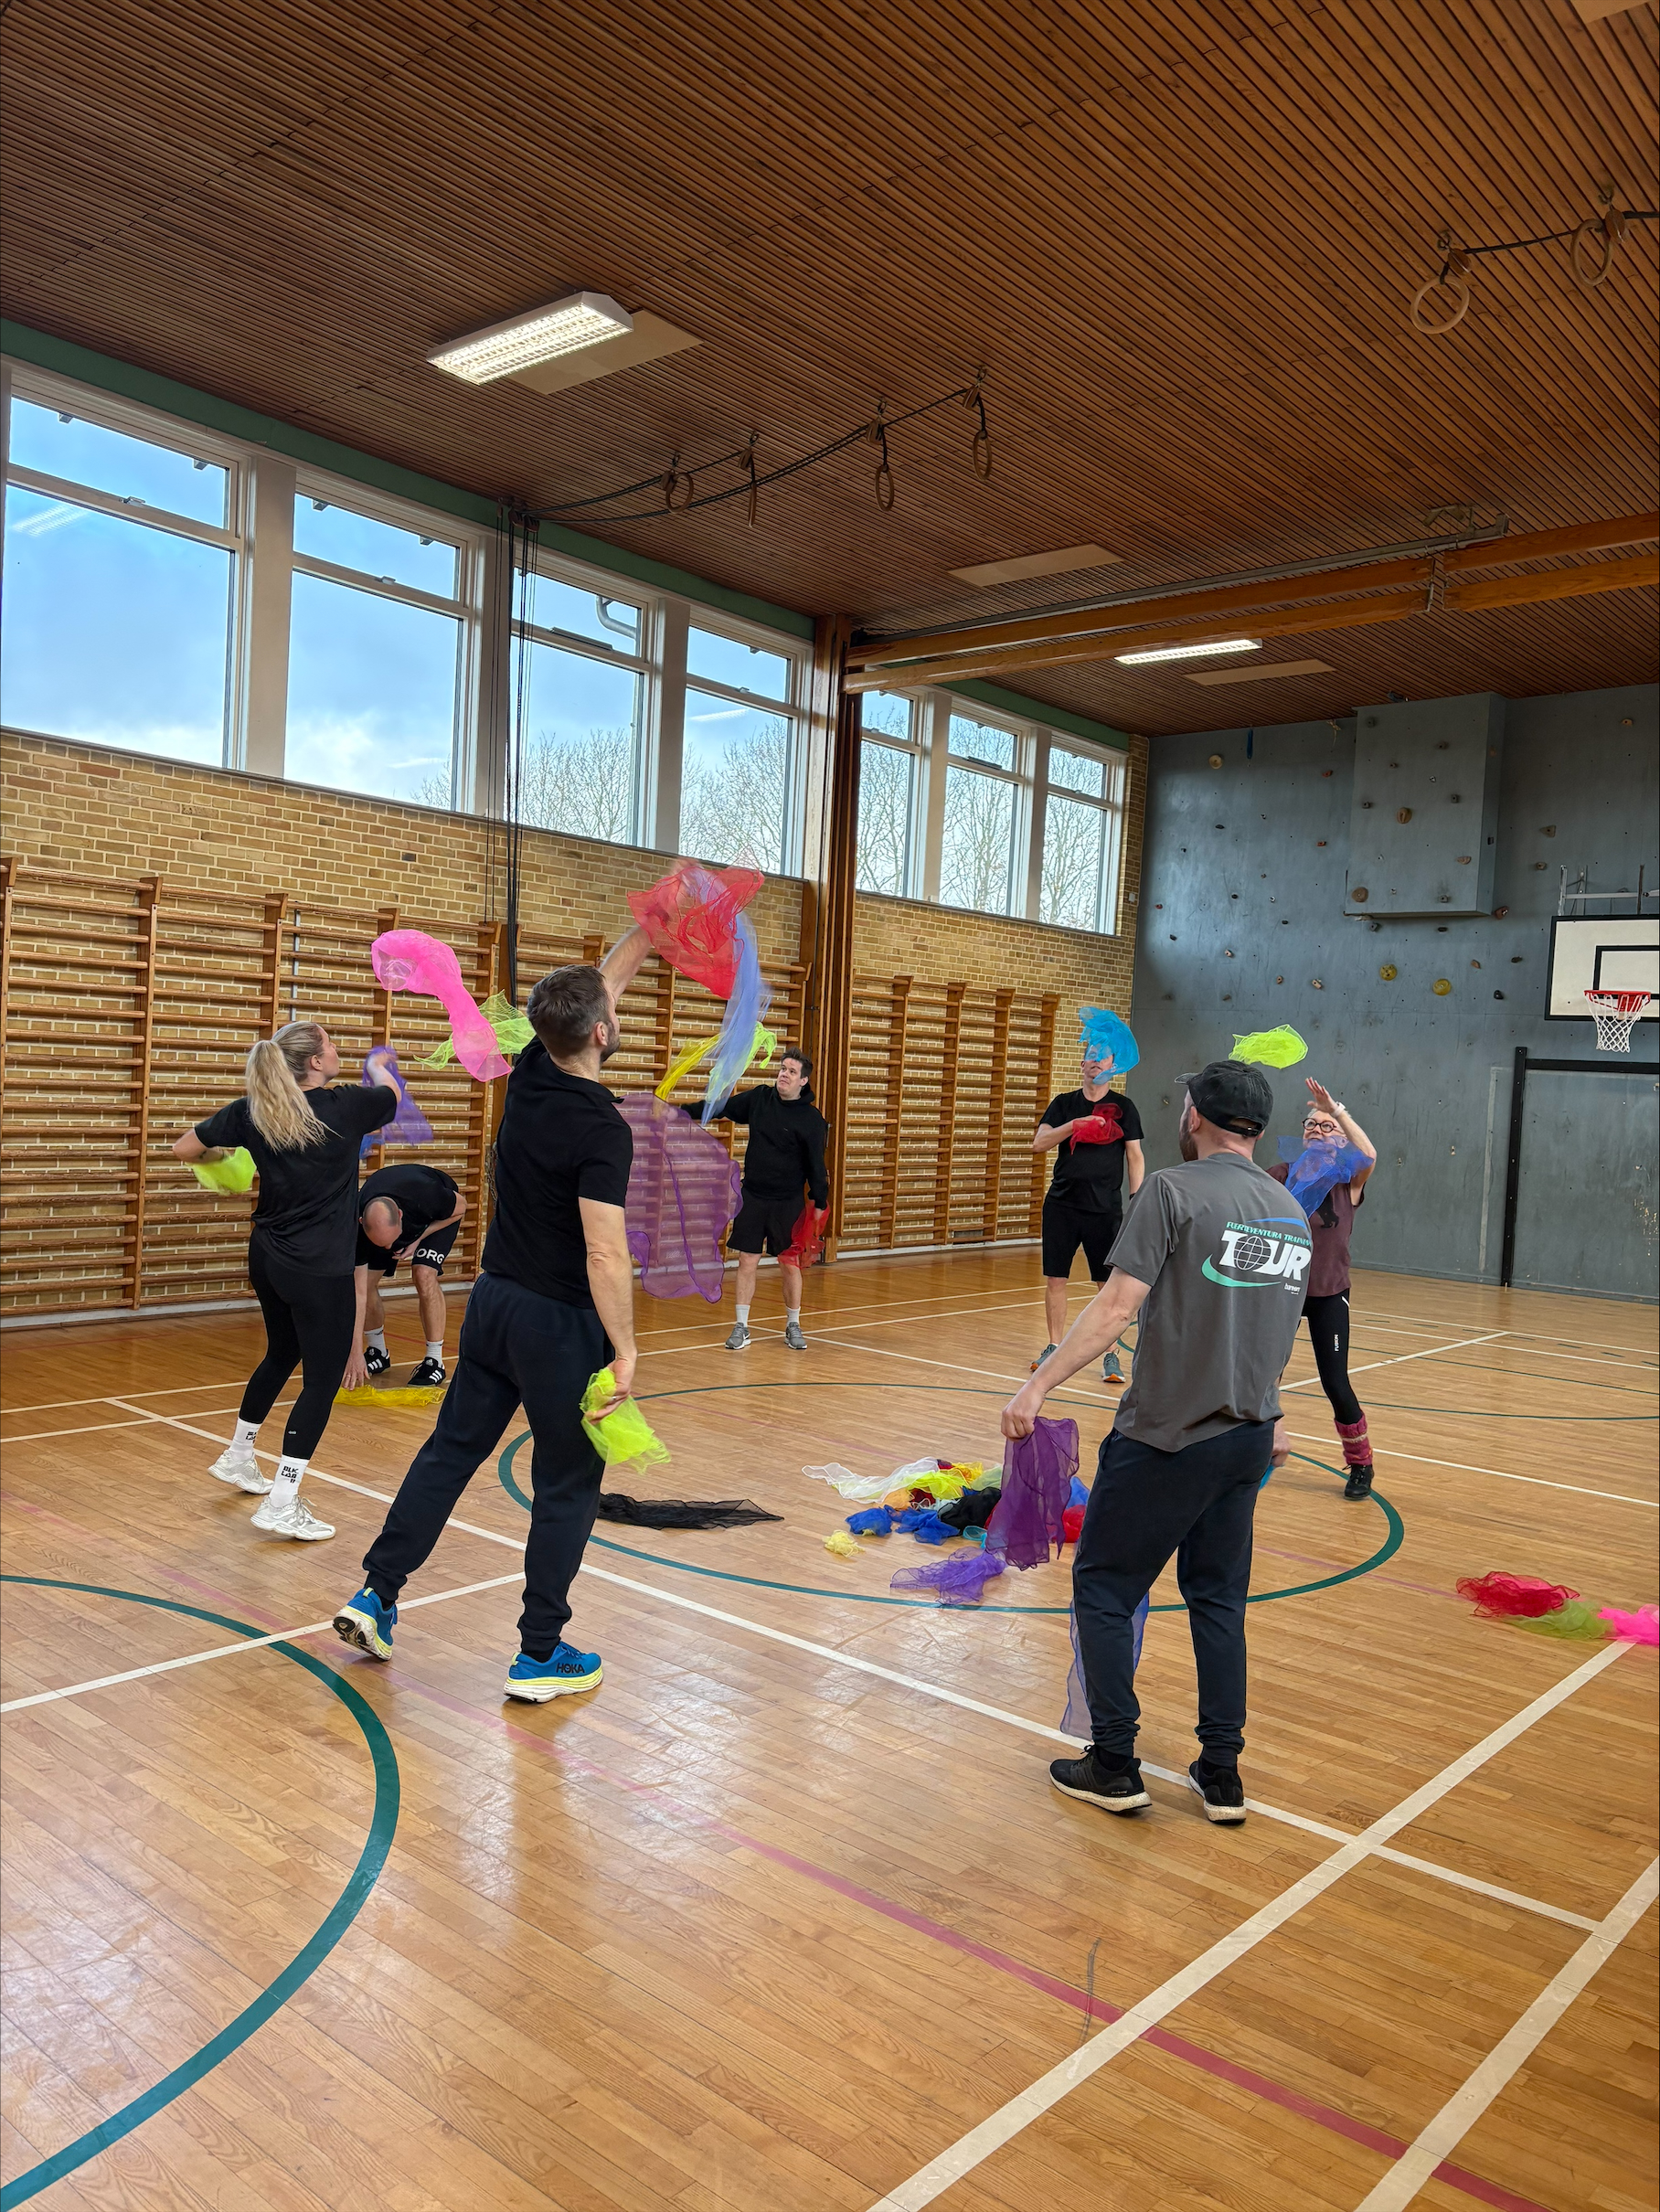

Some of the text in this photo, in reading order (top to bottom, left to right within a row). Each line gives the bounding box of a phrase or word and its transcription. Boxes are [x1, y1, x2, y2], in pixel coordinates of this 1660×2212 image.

[1226, 1221, 1312, 1247] FUERTEVENTURA TRAININ
[416, 1248, 445, 1264] ORG
[1218, 1229, 1312, 1281] TOUR
[556, 1662, 585, 1675] HOKA
